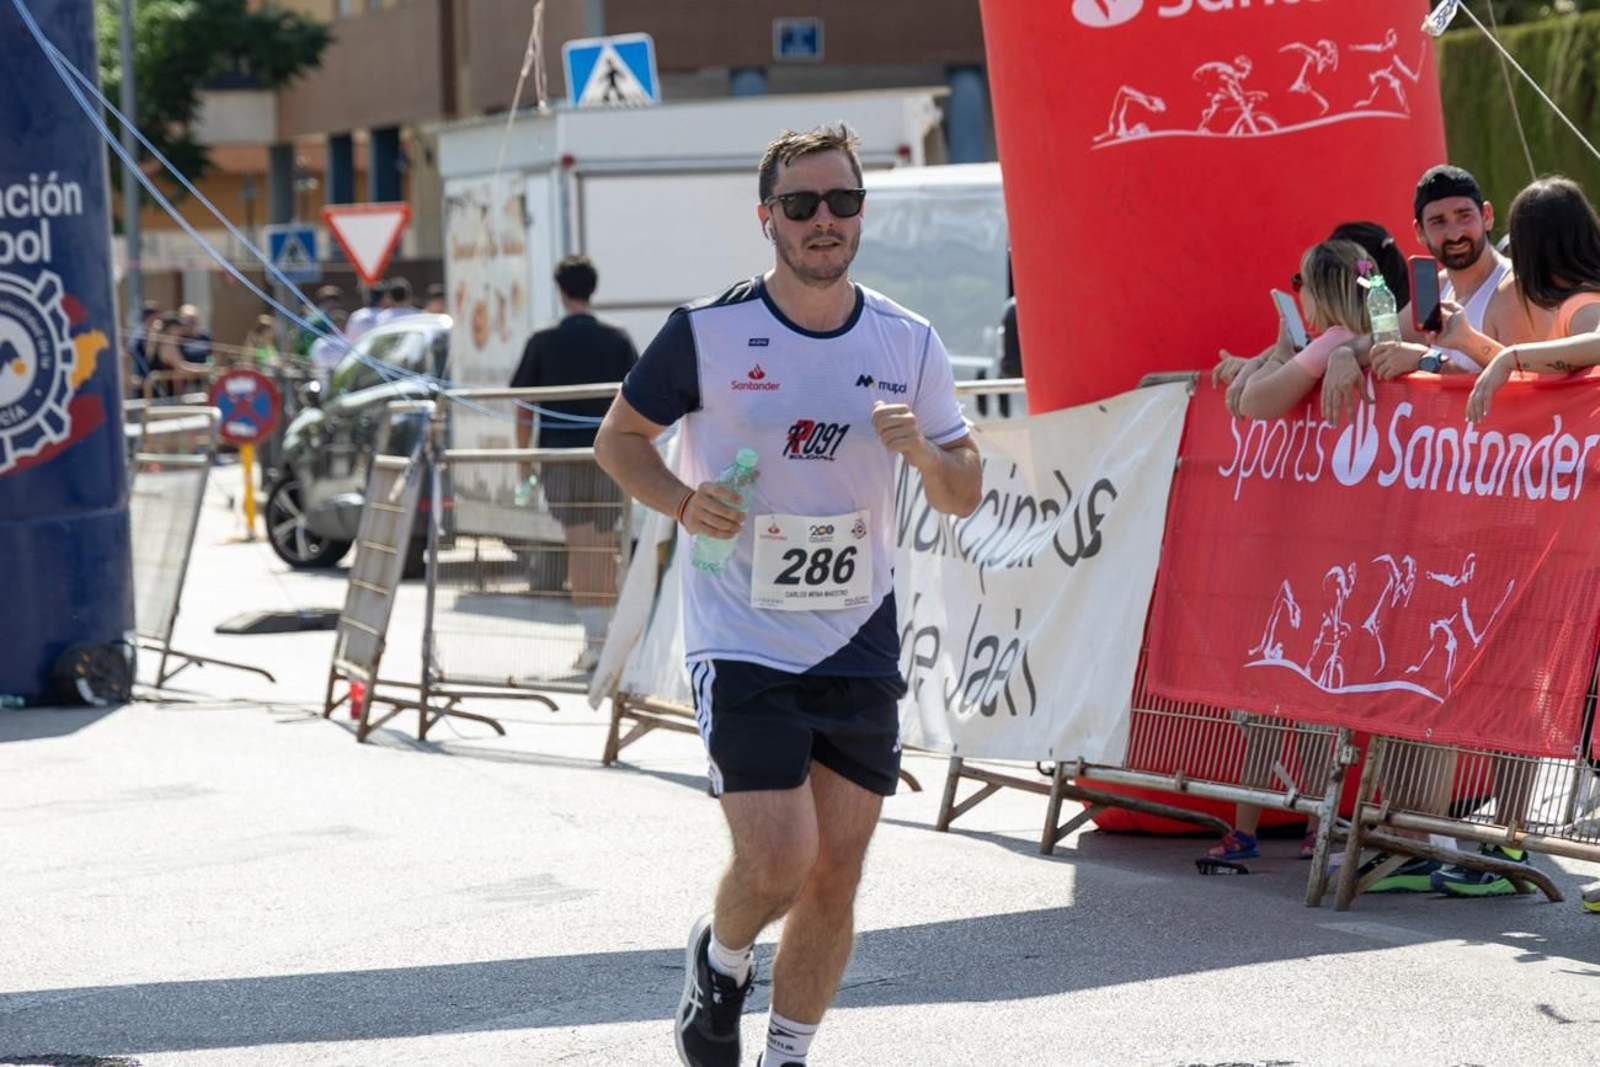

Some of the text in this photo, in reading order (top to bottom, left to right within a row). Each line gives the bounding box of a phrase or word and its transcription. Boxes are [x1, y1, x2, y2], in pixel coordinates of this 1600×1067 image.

[0, 171, 83, 218] ción
[731, 380, 780, 391] Santander
[1218, 402, 1600, 500] Sports Santander
[774, 546, 857, 585] 286
